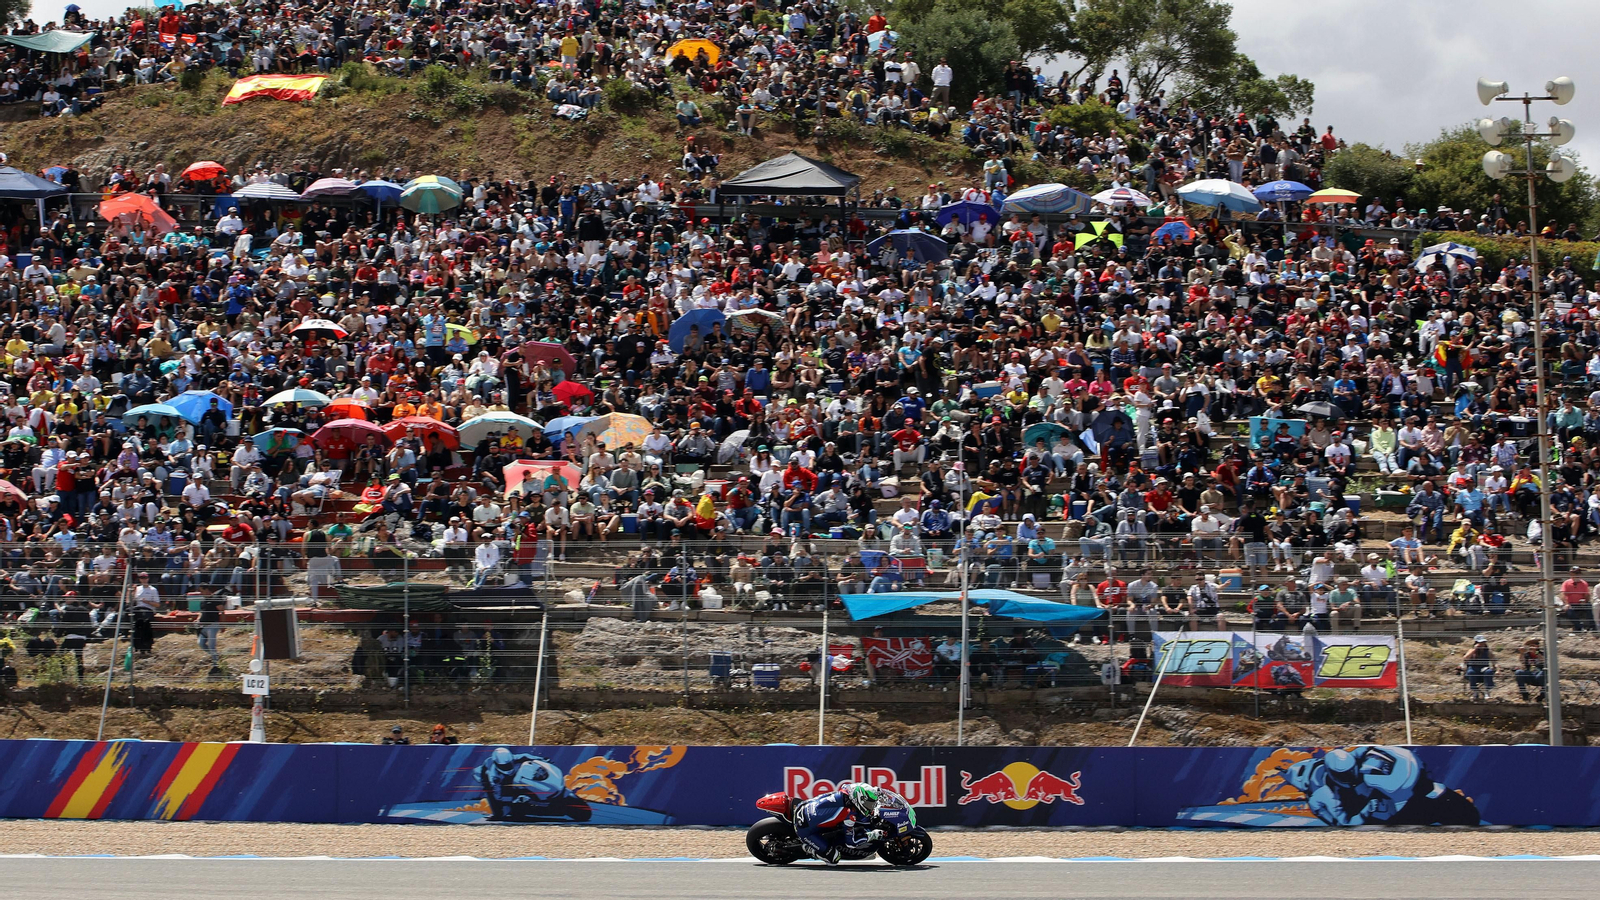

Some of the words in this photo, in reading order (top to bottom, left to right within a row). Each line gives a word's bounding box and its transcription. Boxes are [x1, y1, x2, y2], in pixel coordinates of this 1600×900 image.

[1154, 639, 1231, 675] 12
[1317, 644, 1393, 680] 12
[867, 766, 947, 807] Bull
